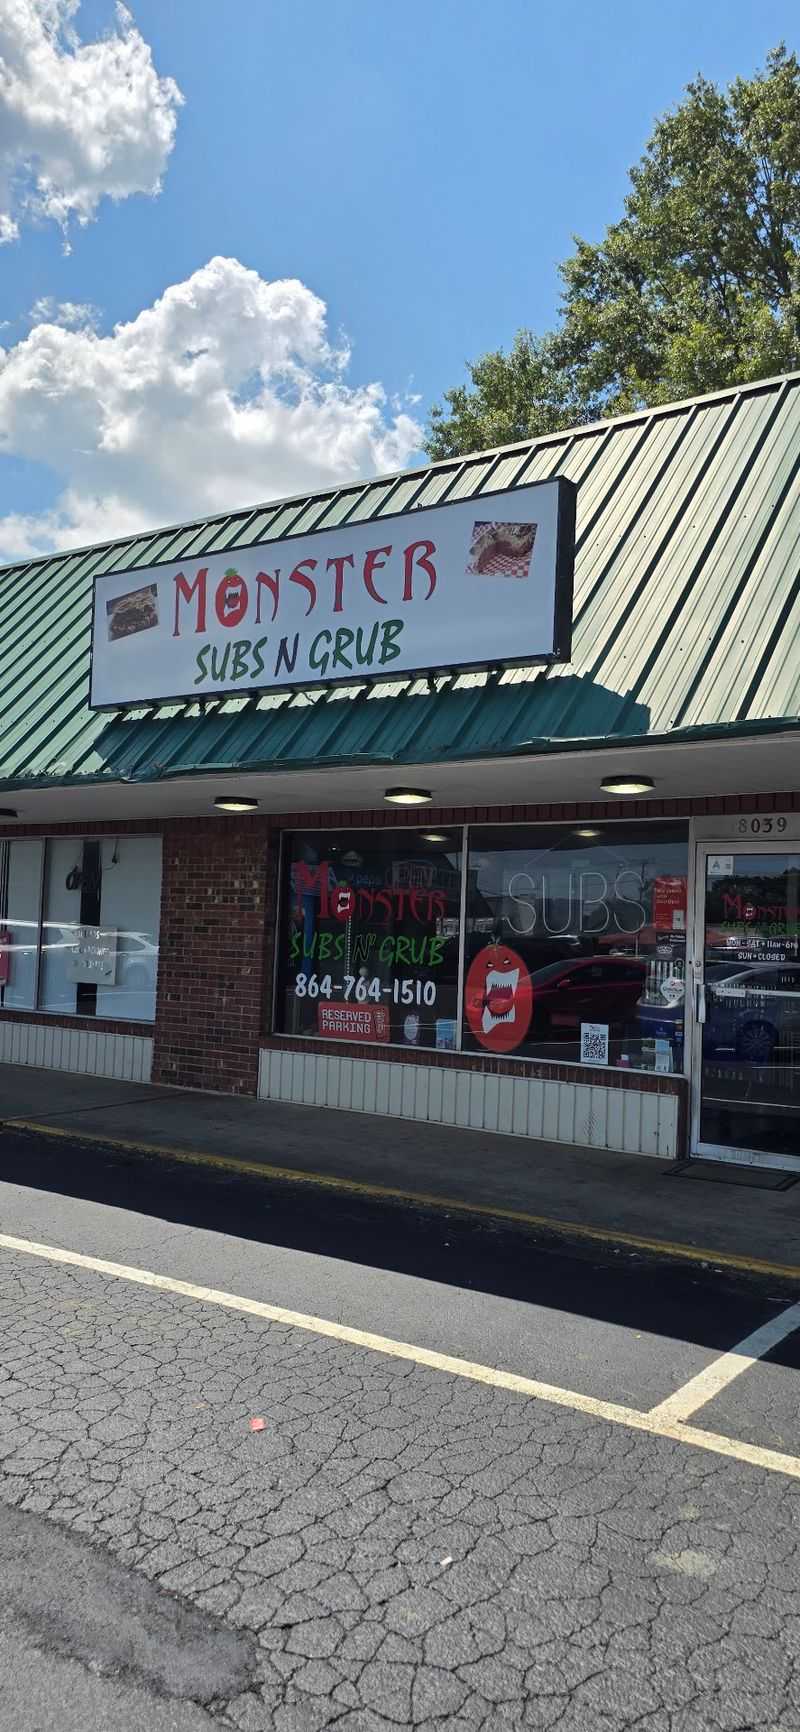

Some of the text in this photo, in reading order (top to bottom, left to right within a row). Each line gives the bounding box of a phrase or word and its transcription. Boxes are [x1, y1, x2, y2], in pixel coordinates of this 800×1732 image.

[172, 540, 438, 637] MONSTER
[194, 619, 405, 685] SUBS N GRUB
[738, 817, 787, 833] 8039
[503, 871, 646, 934] SUBS
[290, 931, 345, 960] SUBS
[378, 936, 447, 966] GRUB
[294, 972, 437, 1006] 864-764-1510
[321, 1008, 372, 1024] RESERVED
[321, 1020, 371, 1035] PARKING
